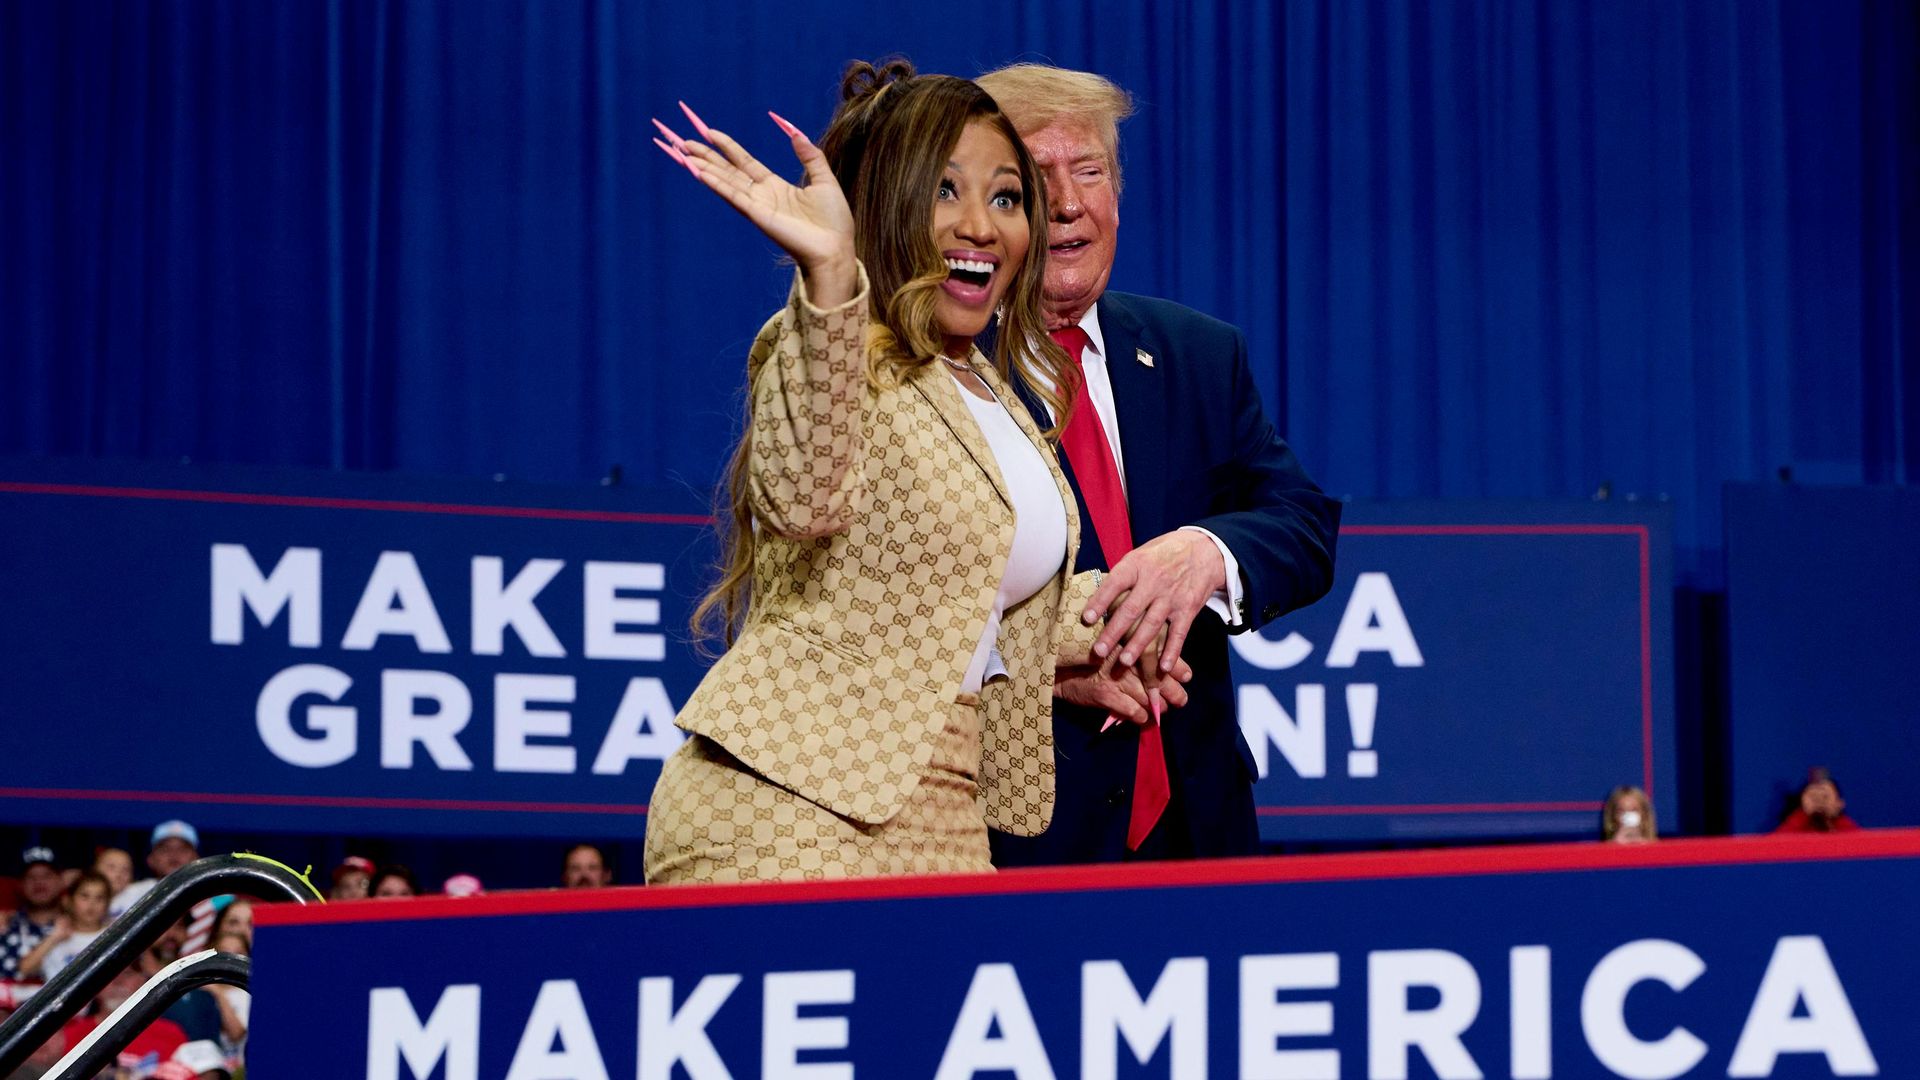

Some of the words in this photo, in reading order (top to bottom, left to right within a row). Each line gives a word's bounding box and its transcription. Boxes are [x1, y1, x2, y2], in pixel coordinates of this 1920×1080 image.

[210, 543, 666, 662] MAKE
[255, 663, 688, 775] GREA
[366, 969, 856, 1080] MAKE
[933, 935, 1879, 1080] AMERICA
